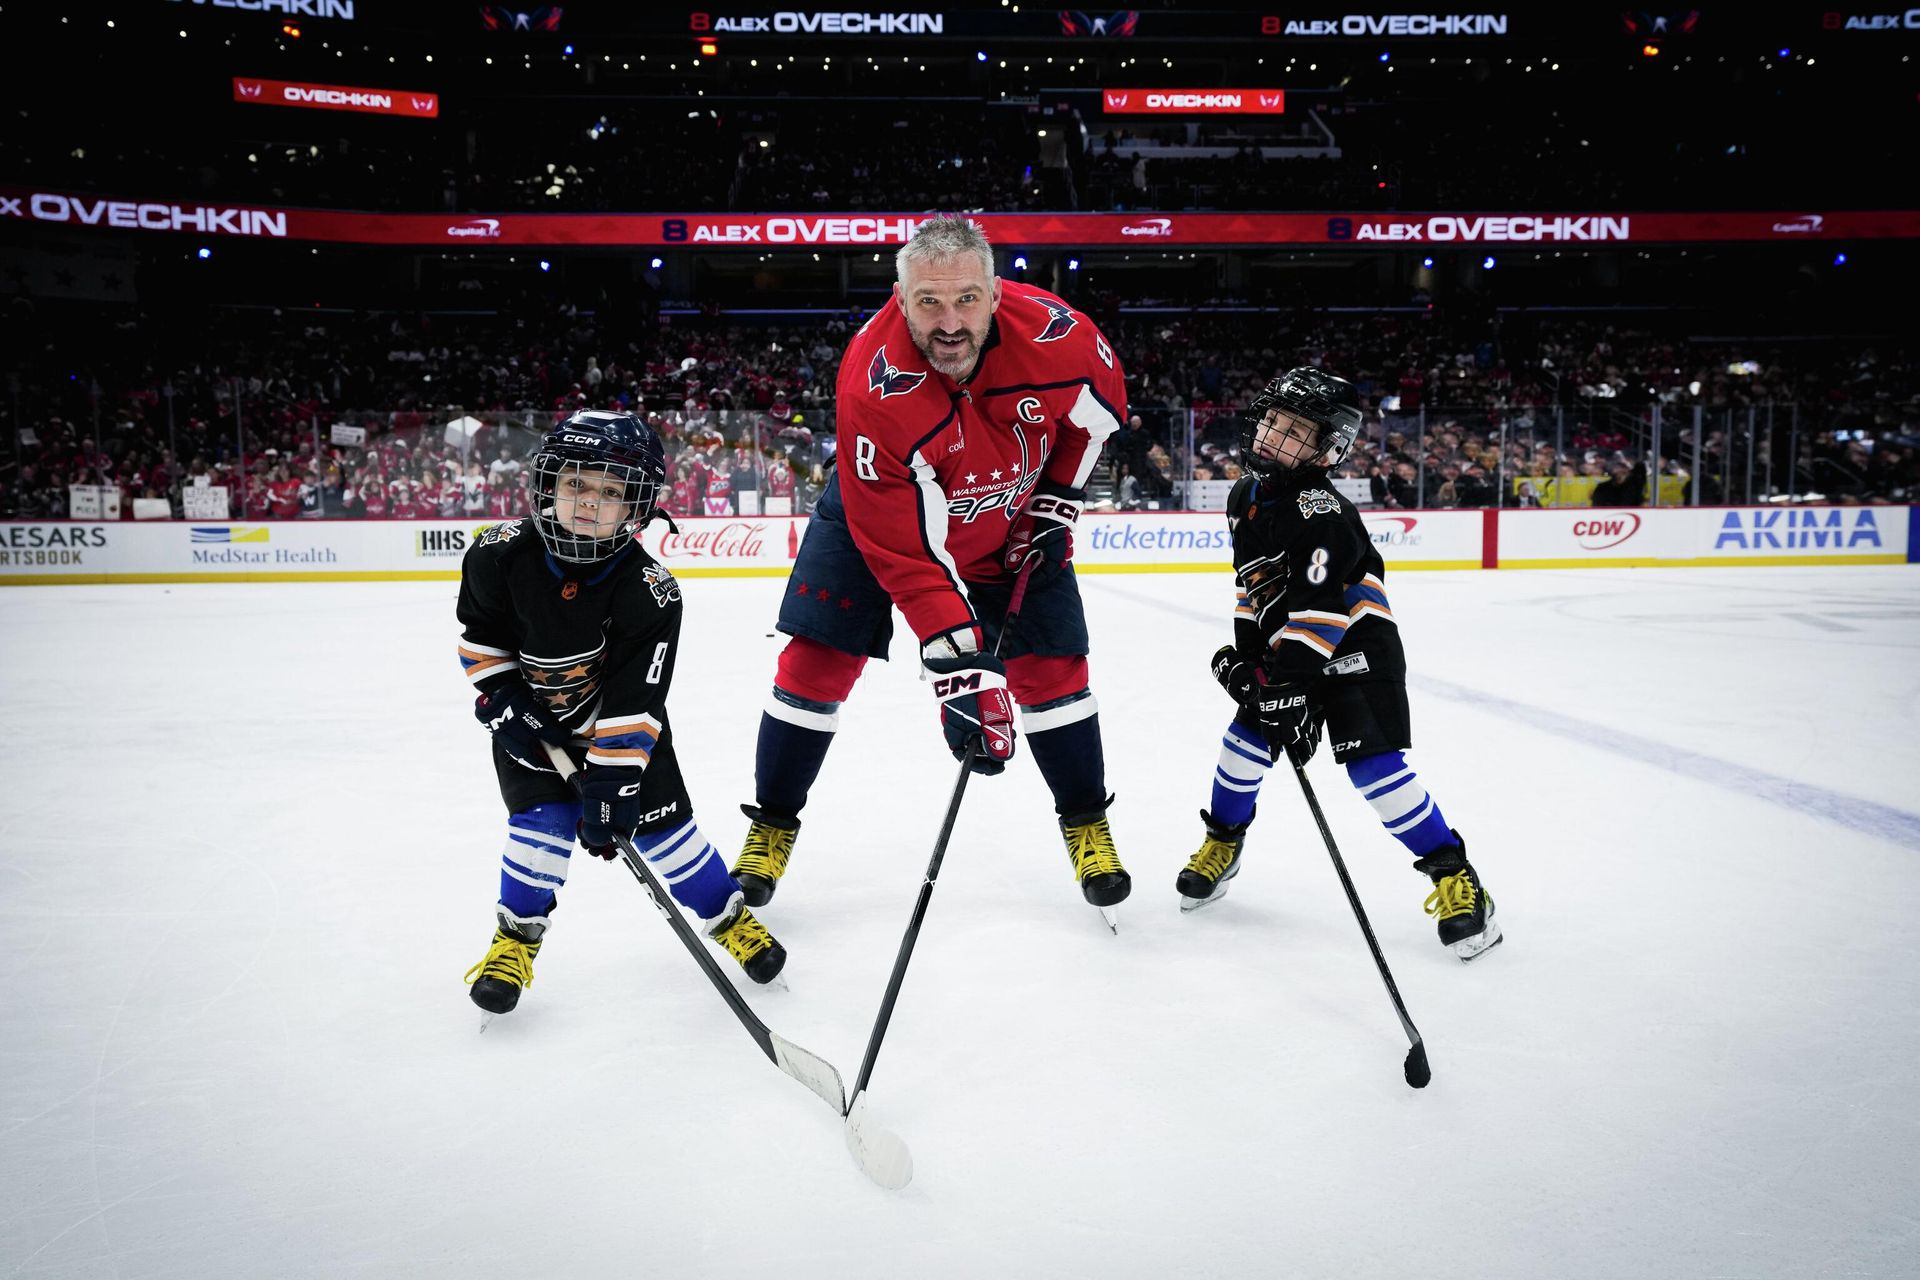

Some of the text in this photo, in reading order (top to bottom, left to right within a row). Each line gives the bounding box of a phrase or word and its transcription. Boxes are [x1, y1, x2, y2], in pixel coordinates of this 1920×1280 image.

[690, 13, 943, 33] 8 ALEX OVECHKIN
[1262, 15, 1507, 34] 8 ALEX OVECHKIN
[1845, 16, 1899, 29] ALEX
[284, 87, 391, 108] OVECHKIN
[1146, 95, 1241, 108] OVECHKIN
[31, 194, 287, 236] OVECHKIN
[662, 218, 974, 242] 8 ALEX OVECHK
[1327, 217, 1630, 241] 8 ALEX OVECHKIN
[1096, 332, 1114, 370] 8
[1016, 396, 1046, 424] C
[563, 434, 601, 446] CCM
[855, 434, 880, 481] 8
[422, 530, 466, 551] HHS
[659, 522, 768, 558] Coca-Cola
[1573, 520, 1625, 537] CDW
[1714, 509, 1883, 550] AKIMA
[193, 548, 338, 564] MedStar Health
[1307, 548, 1329, 585] 8
[646, 642, 668, 684] 8
[932, 672, 982, 698] CM
